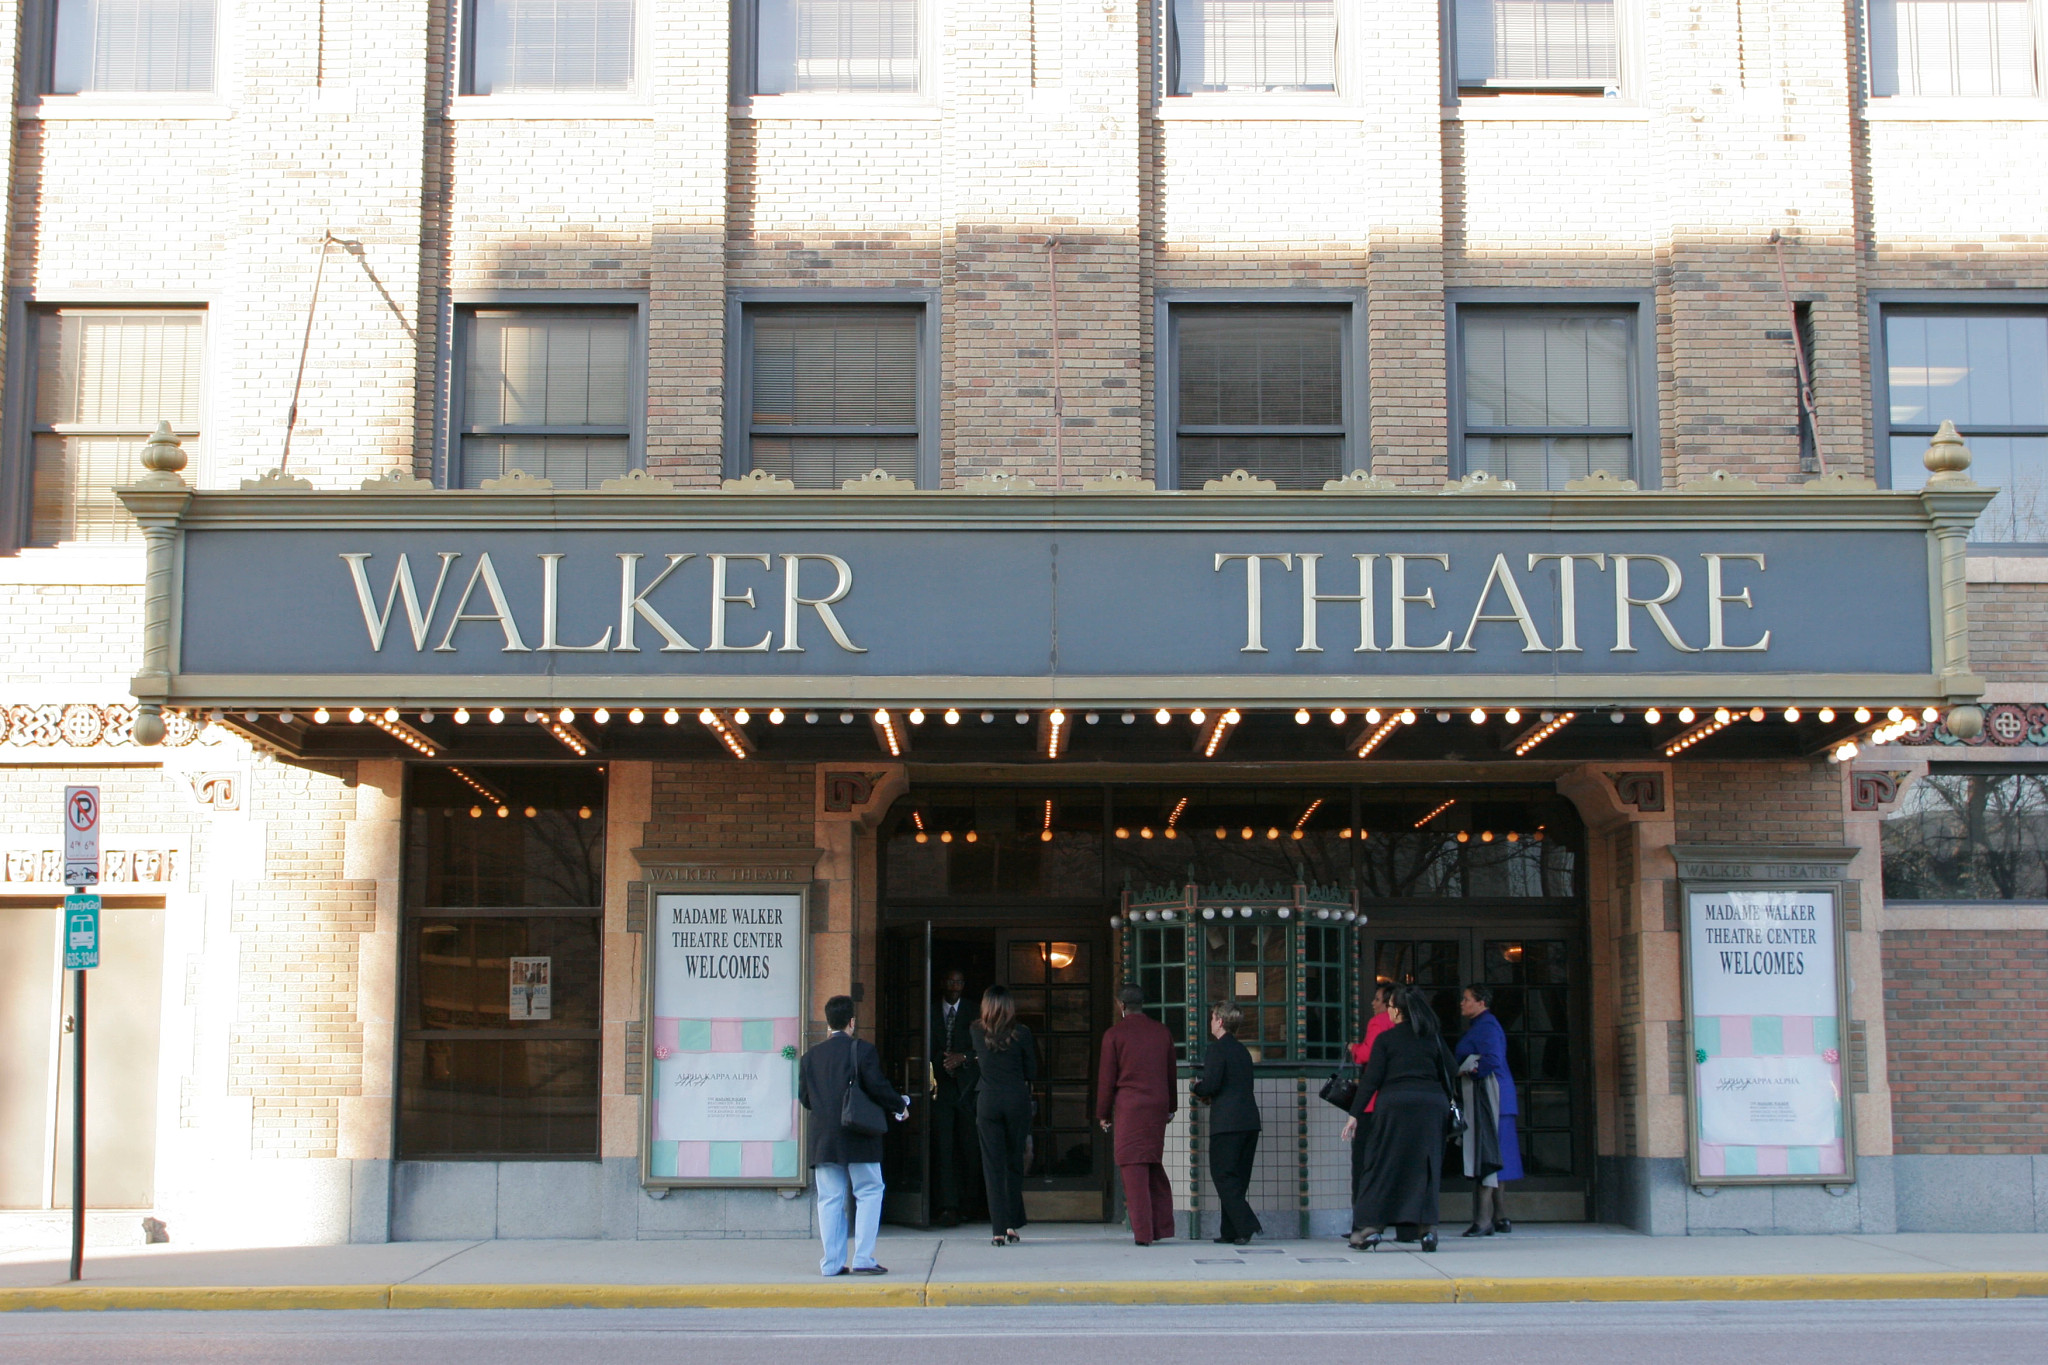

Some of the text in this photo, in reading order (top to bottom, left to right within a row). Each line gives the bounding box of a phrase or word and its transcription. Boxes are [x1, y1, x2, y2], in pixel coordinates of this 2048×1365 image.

[339, 552, 1770, 653] WALKER THEATRE
[649, 868, 718, 881] WALKER
[1685, 865, 1839, 879] WALKER THEATRE
[67, 900, 99, 912] IndyGo
[1705, 904, 1816, 921] MADAME WALKER
[672, 908, 783, 925] MADAME WALKER
[672, 931, 783, 948] THEATRE CENTER
[1705, 928, 1817, 944] THEATRE CENTER
[686, 955, 770, 979] WELCOMES
[1720, 951, 1804, 975] WELCOMES
[677, 1073, 758, 1081] ALPHA KAPPA ALPHA
[1745, 1077, 1772, 1085] KAPPA
[1775, 1077, 1800, 1085] ALPHA
